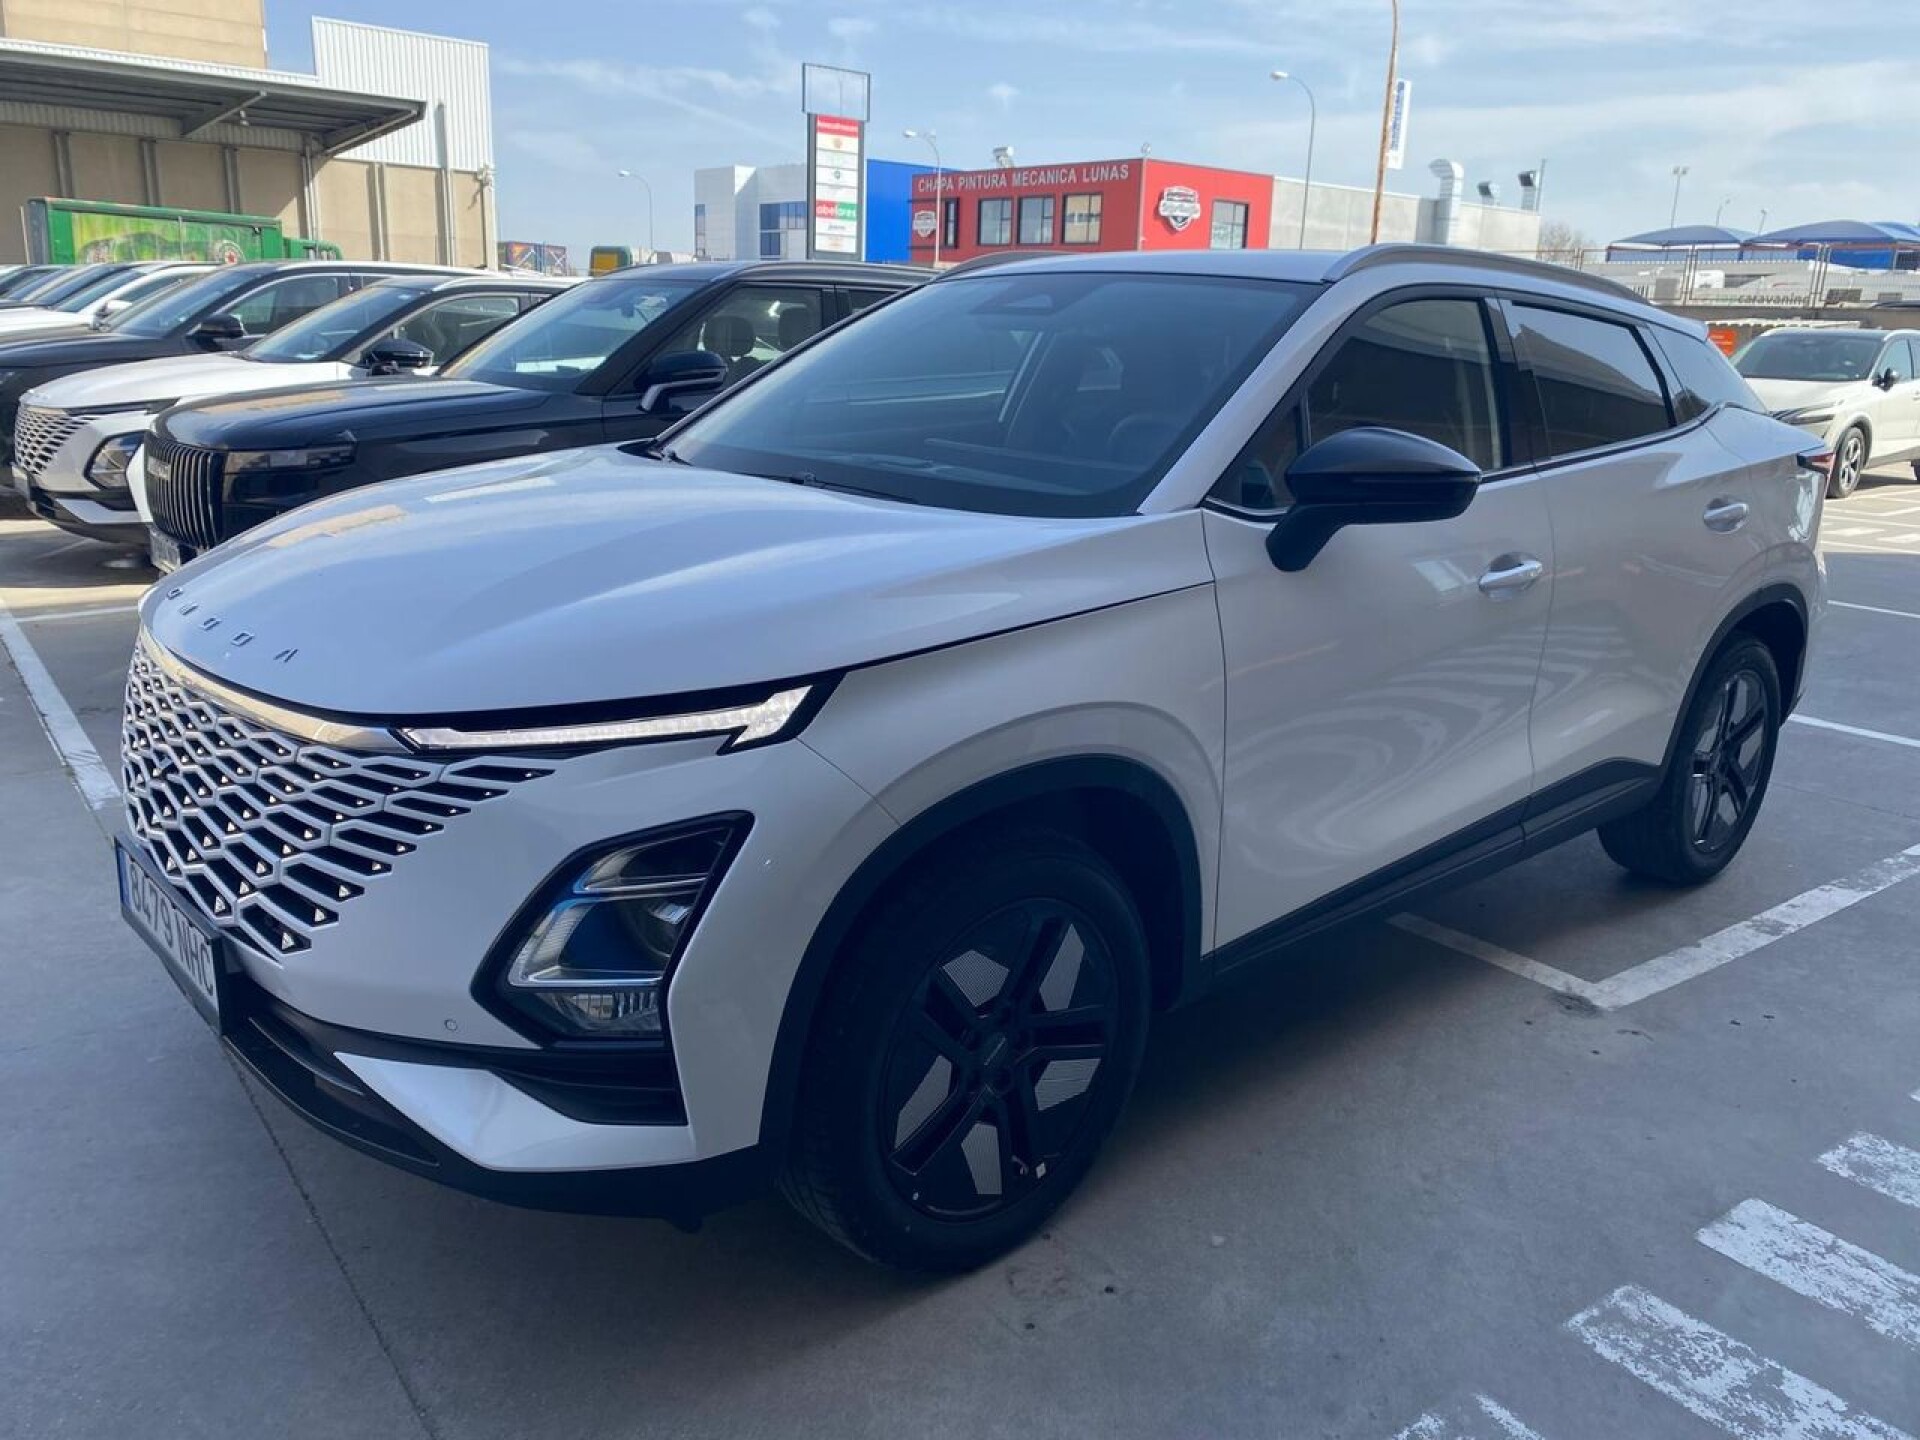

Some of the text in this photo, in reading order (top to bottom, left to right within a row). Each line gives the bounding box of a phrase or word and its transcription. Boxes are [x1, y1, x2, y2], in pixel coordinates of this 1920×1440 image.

[918, 164, 1129, 192] CHAPA PINTURA MECANICA LUNAS
[175, 911, 214, 997] NHC
